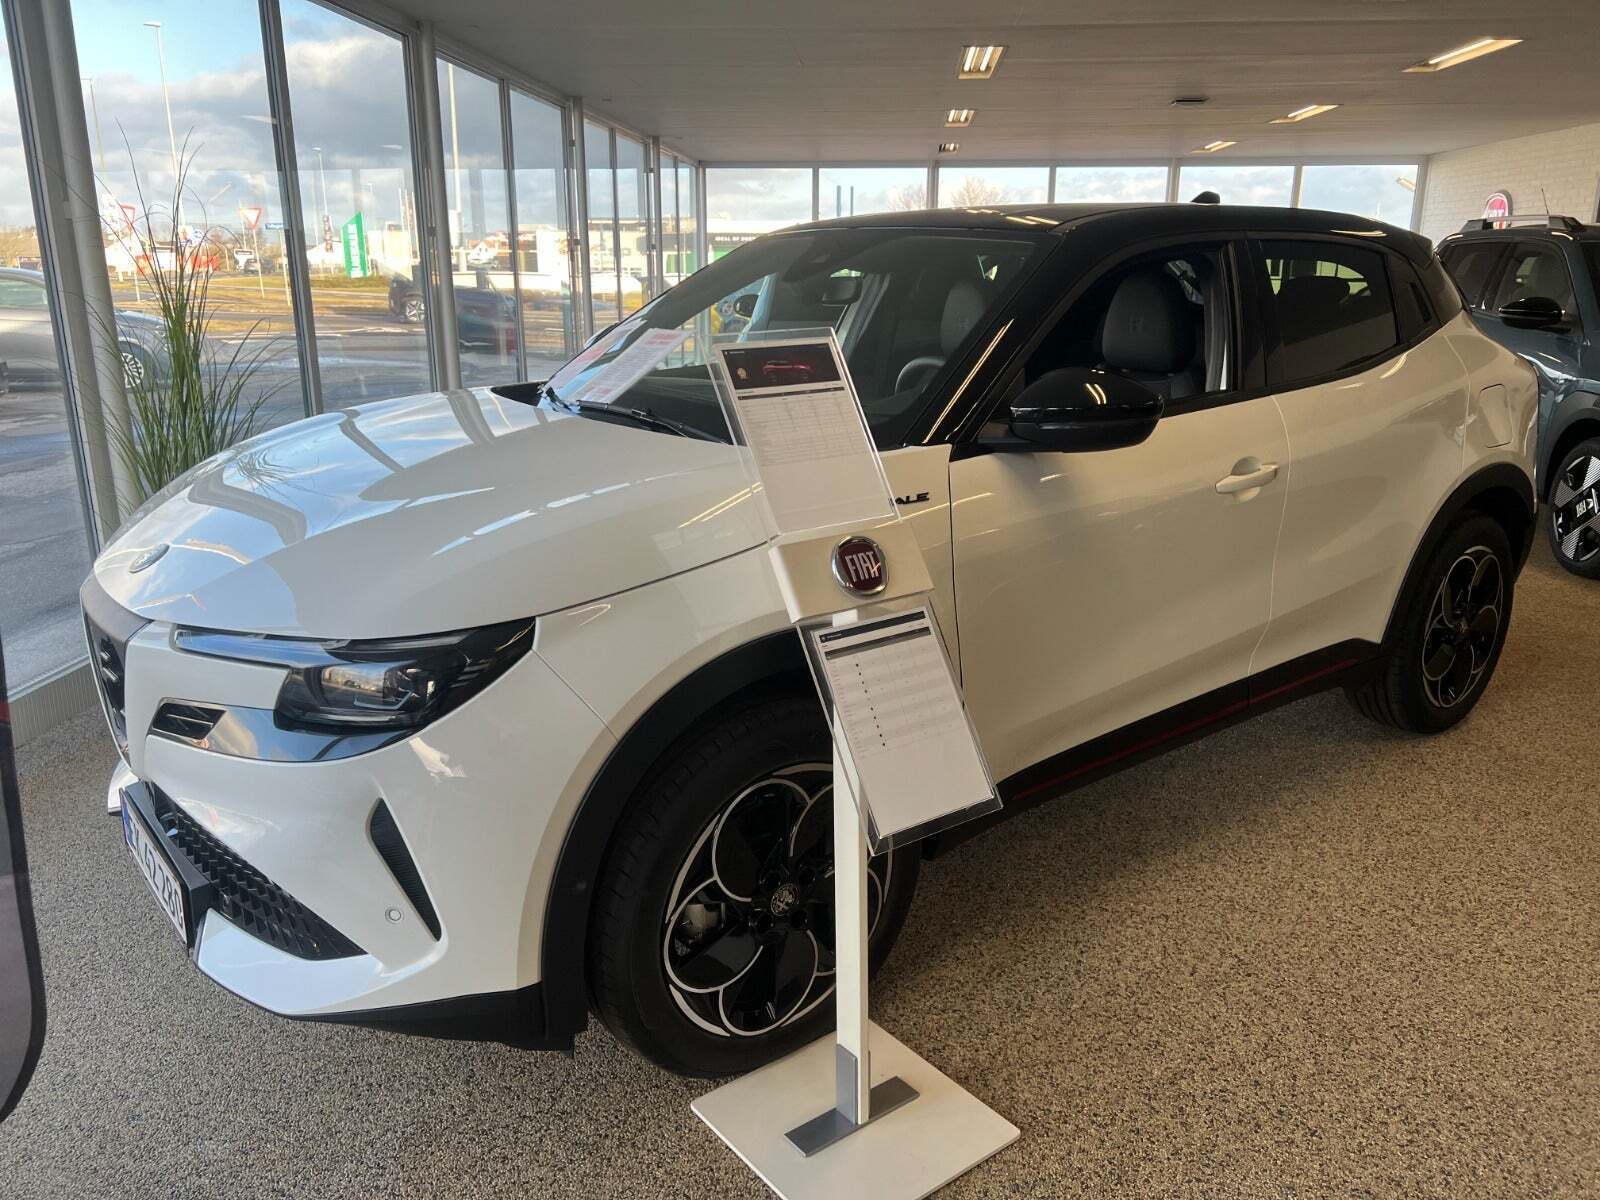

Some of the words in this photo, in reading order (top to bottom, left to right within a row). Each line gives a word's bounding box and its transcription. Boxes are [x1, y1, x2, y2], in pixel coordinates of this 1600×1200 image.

[845, 551, 879, 582] FIAT
[144, 841, 159, 891] 42
[158, 862, 184, 930] 280
